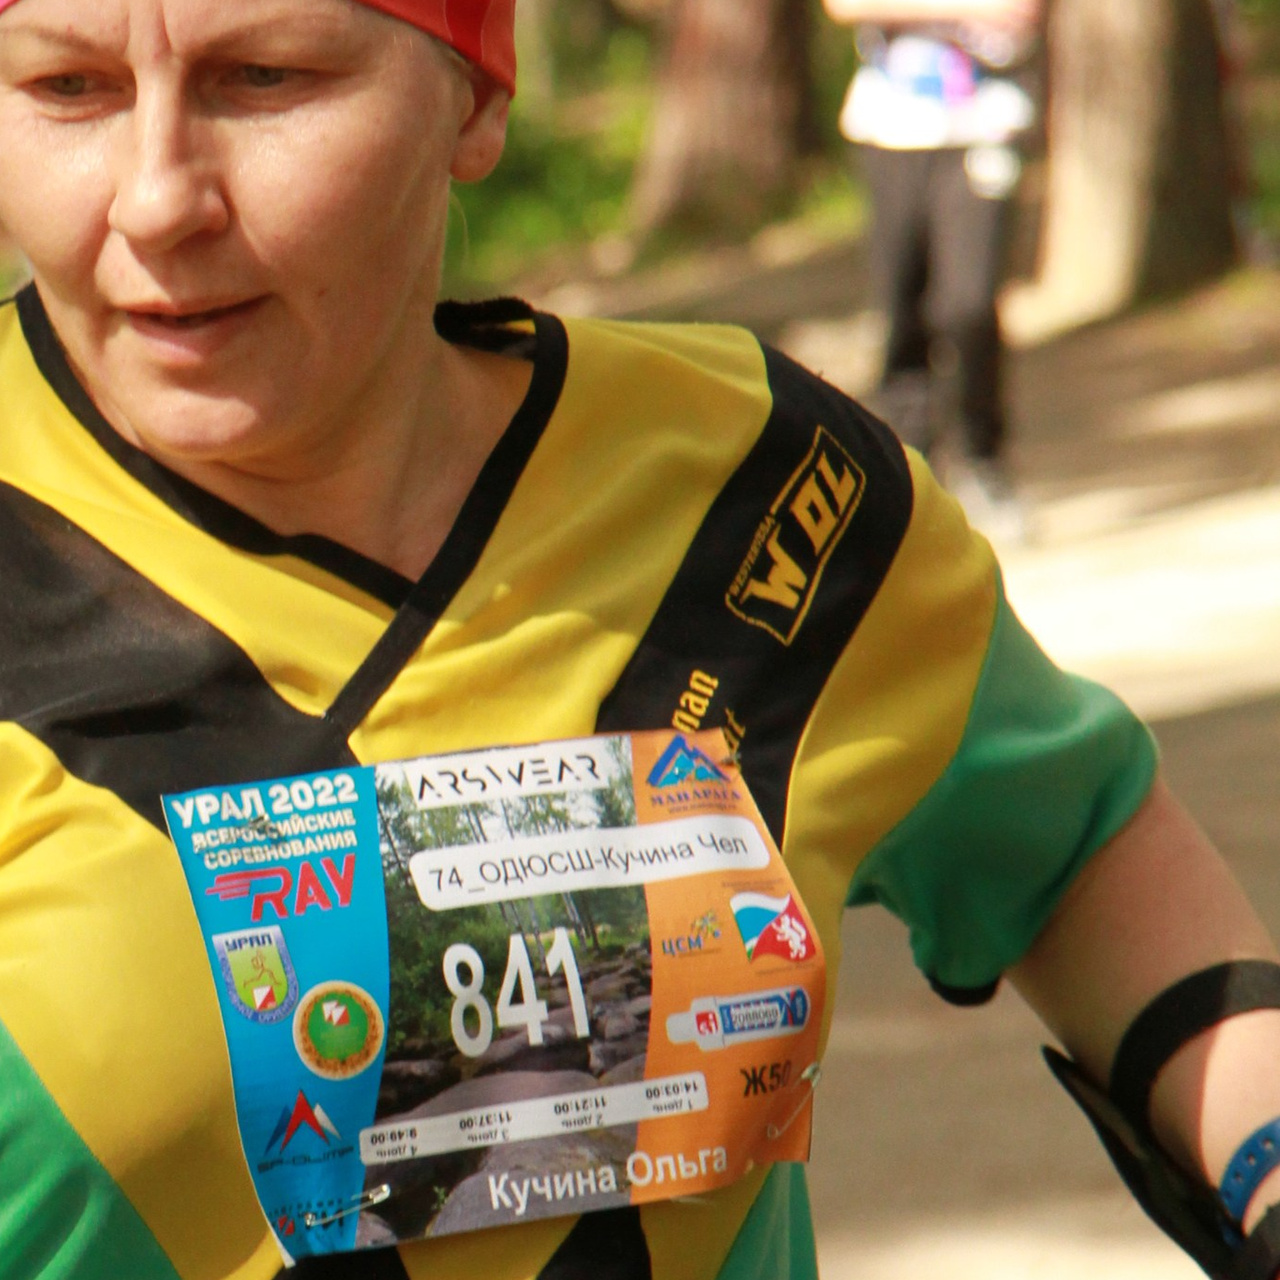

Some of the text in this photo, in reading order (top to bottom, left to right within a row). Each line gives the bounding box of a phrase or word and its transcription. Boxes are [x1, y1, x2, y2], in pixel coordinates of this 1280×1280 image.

[417, 753, 600, 802] ARSWEAR
[171, 773, 359, 828] УРАЛ 2022
[204, 829, 358, 871] СОРЕВНОВАНИЯ
[697, 832, 749, 857] Чел
[205, 853, 356, 922] RAY
[442, 926, 591, 1059] 841
[553, 1095, 607, 1115] 11:21:00
[645, 1080, 699, 1099] 14:03:00
[458, 1110, 513, 1130] 11:37:00
[487, 1144, 729, 1216] Кучина Ольга
